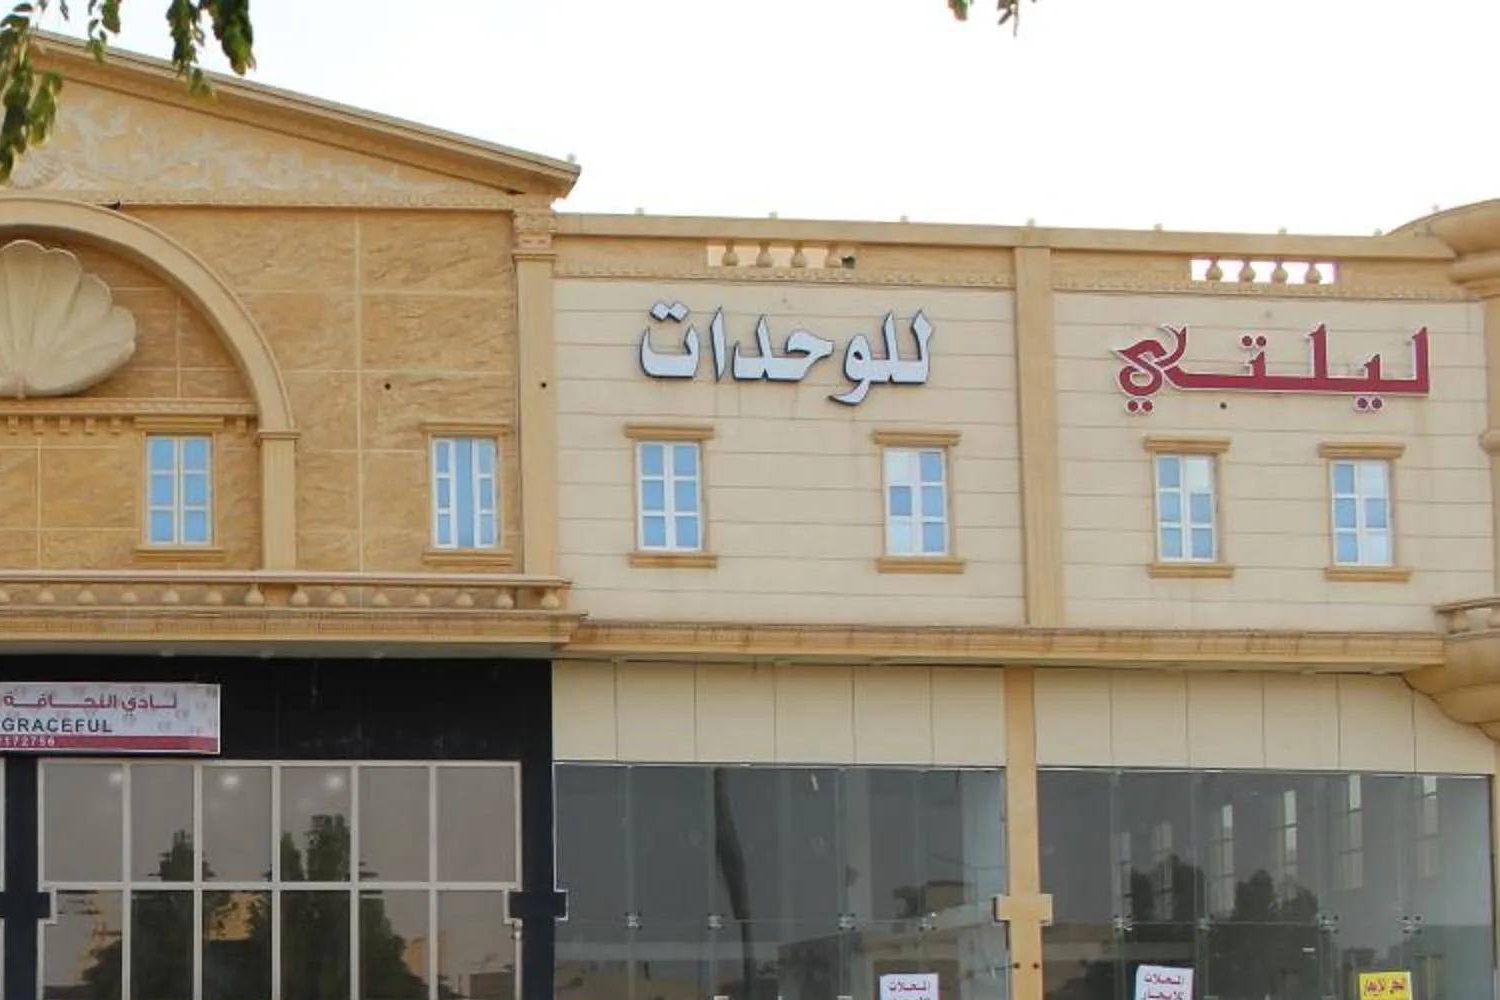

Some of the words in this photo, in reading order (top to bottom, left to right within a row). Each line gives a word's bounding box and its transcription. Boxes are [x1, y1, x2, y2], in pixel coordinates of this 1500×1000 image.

[640, 302, 934, 405] للوحدات
[1110, 321, 1430, 414] ليلتي
[1, 717, 113, 733] GRACEFUL
